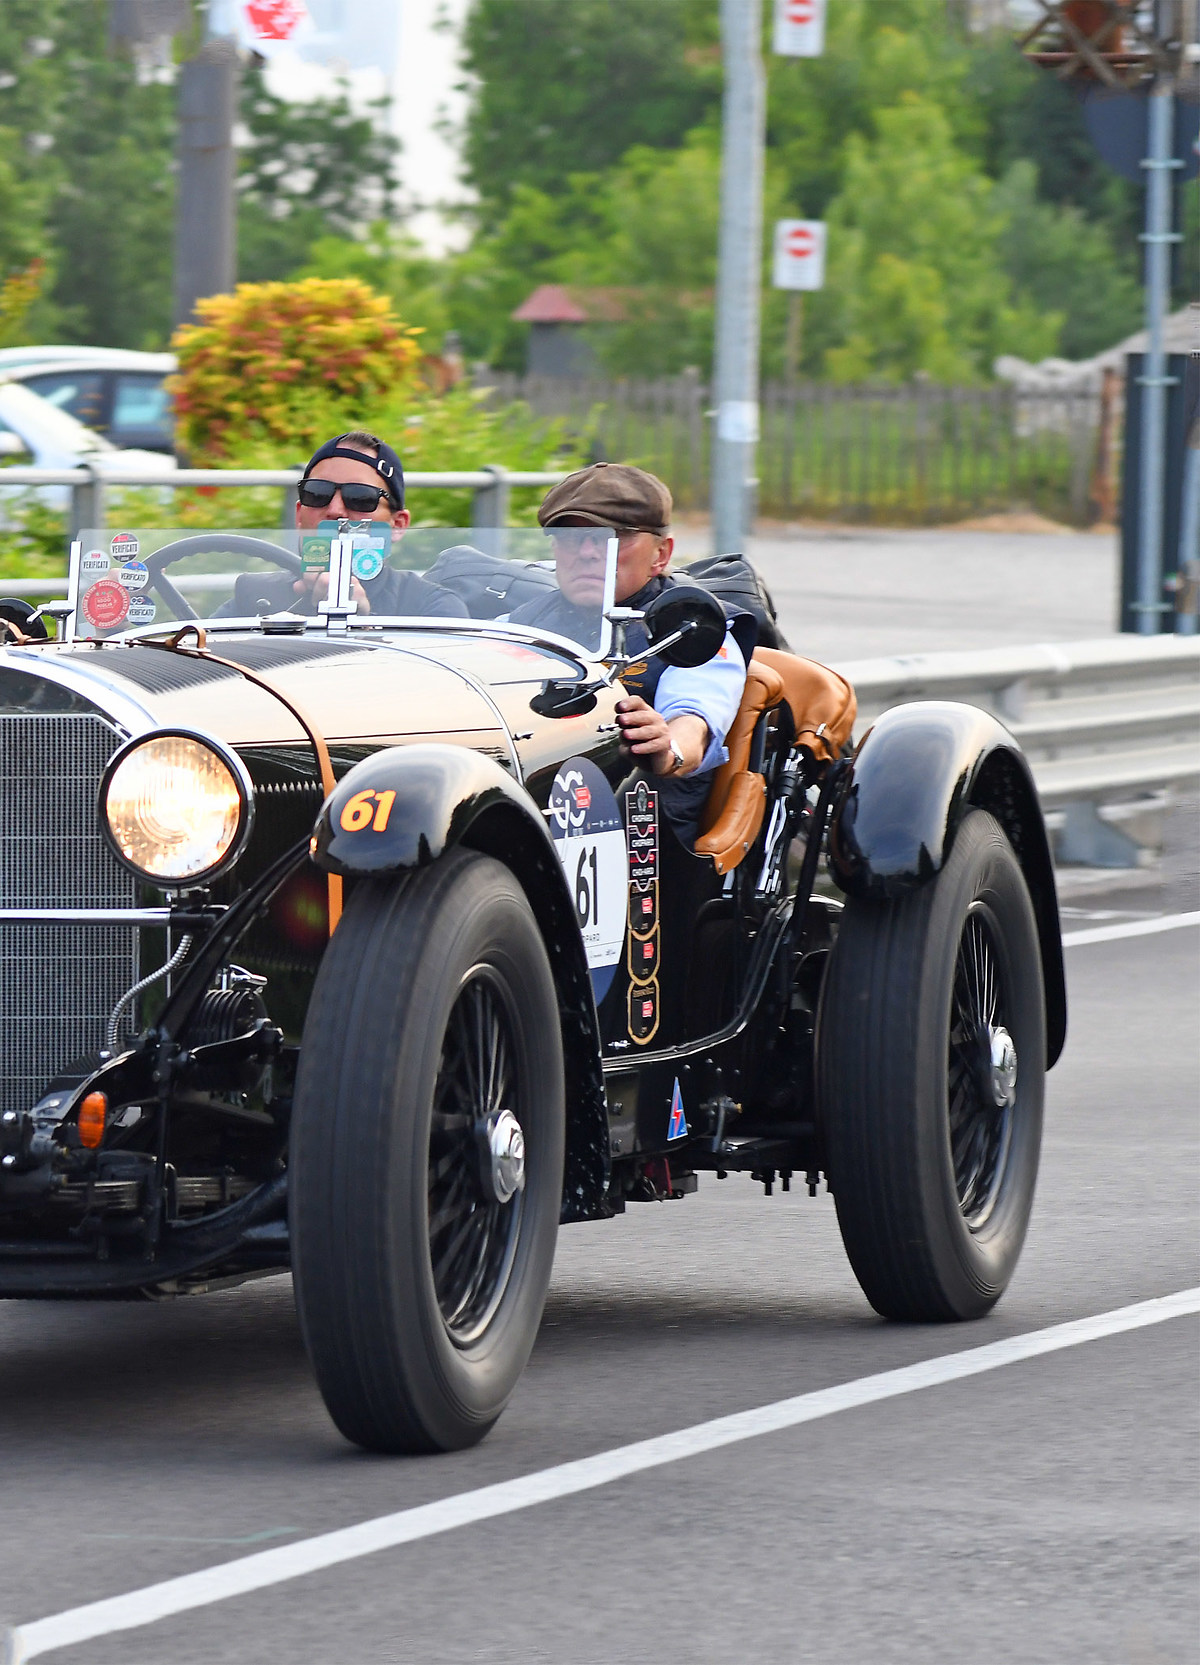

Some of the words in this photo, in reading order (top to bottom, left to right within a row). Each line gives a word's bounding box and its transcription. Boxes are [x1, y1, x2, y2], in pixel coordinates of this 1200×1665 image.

[84, 561, 108, 569] VERIFICATO
[340, 789, 397, 833] 61
[576, 846, 598, 929] 61
